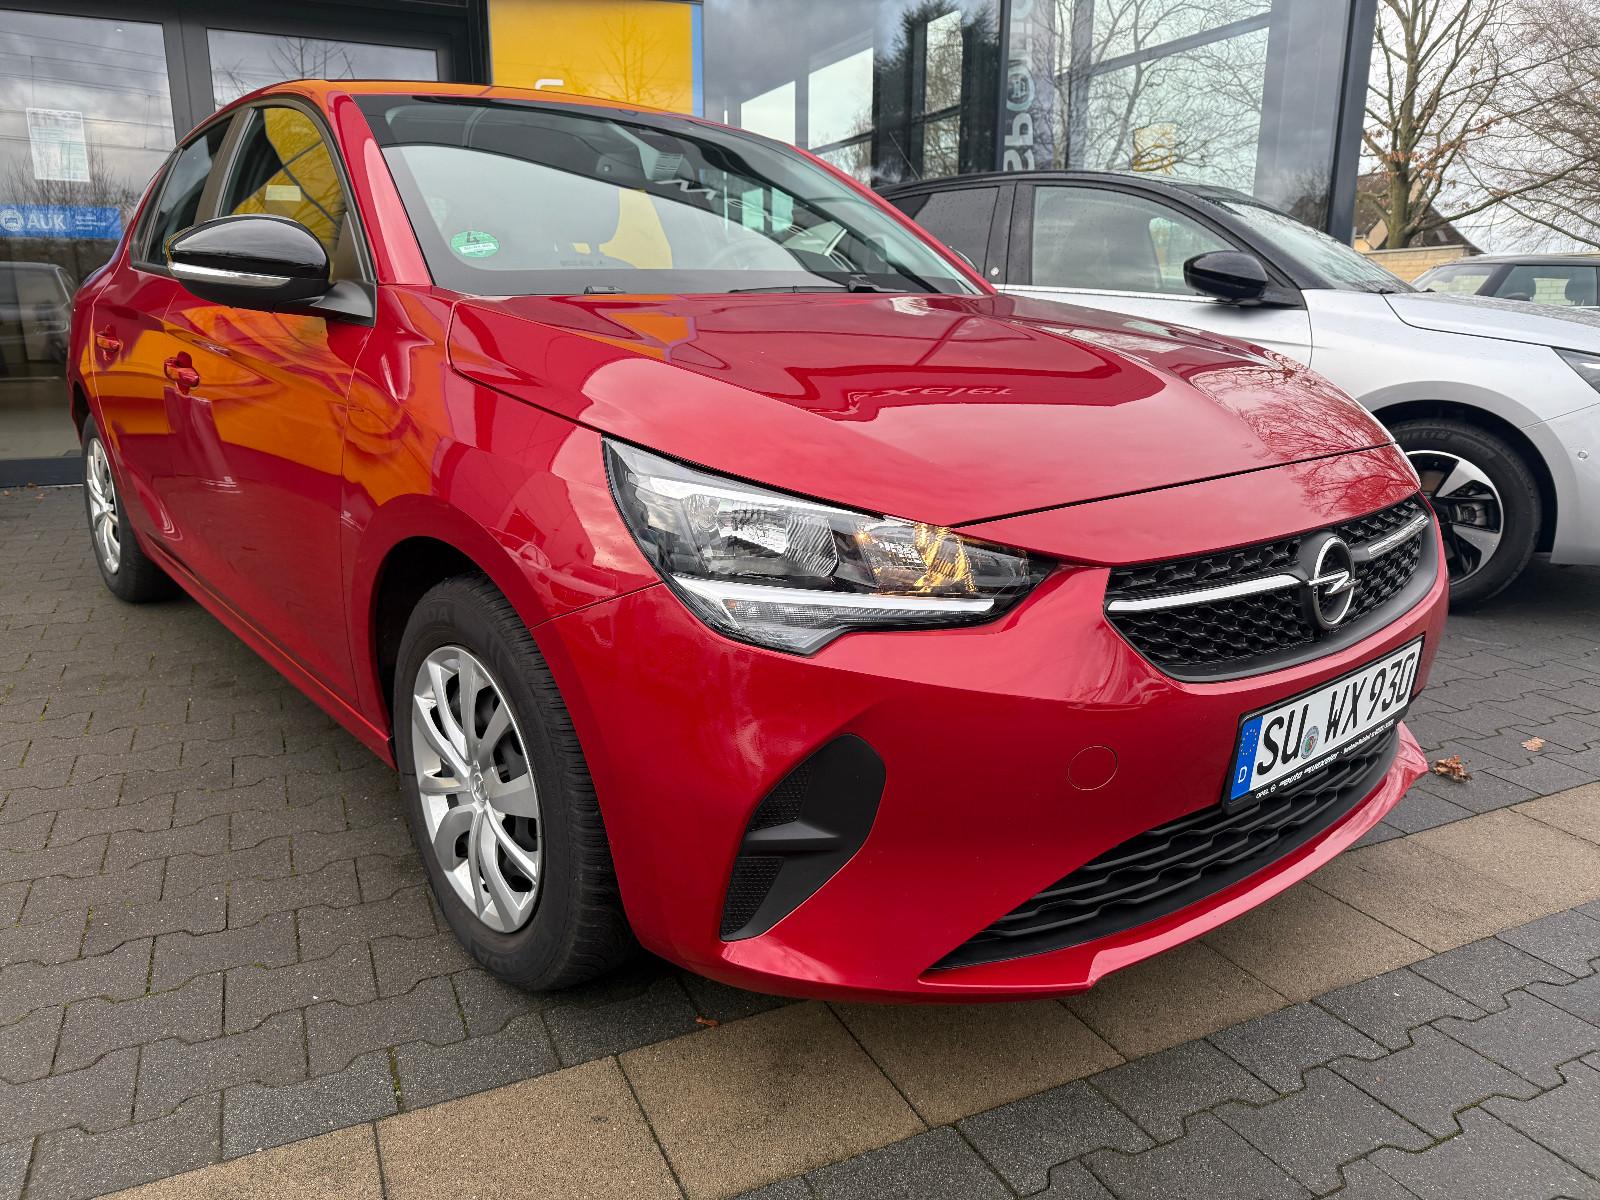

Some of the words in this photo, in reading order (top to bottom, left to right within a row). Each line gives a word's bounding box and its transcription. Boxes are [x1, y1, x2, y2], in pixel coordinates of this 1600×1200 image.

[1238, 766, 1247, 783] D
[1256, 704, 1309, 775] SU
[1324, 676, 1367, 743] WX
[1367, 652, 1415, 720] 930
